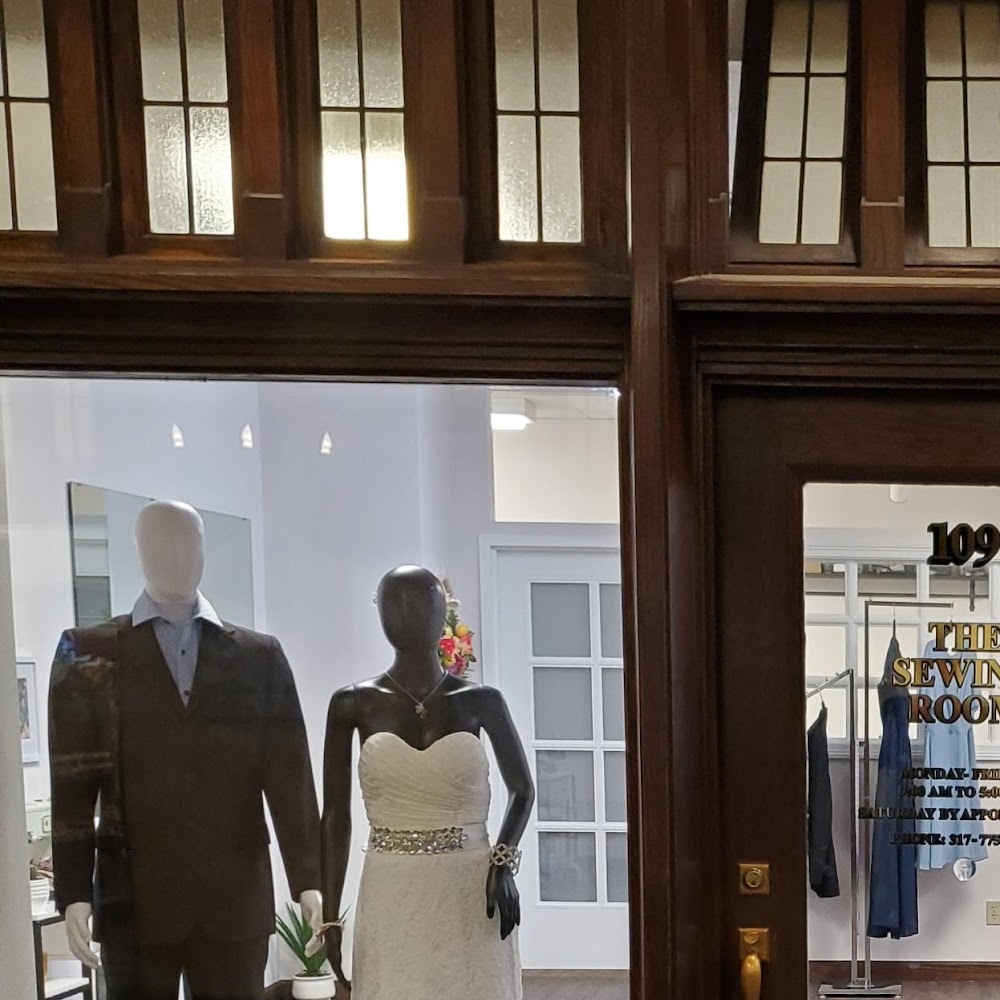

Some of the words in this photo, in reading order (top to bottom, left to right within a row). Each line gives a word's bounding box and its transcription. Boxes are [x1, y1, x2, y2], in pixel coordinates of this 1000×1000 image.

[927, 786, 954, 798] AM
[955, 786, 976, 798] TO
[858, 808, 937, 820] SATURDAY
[938, 809, 959, 821] BY
